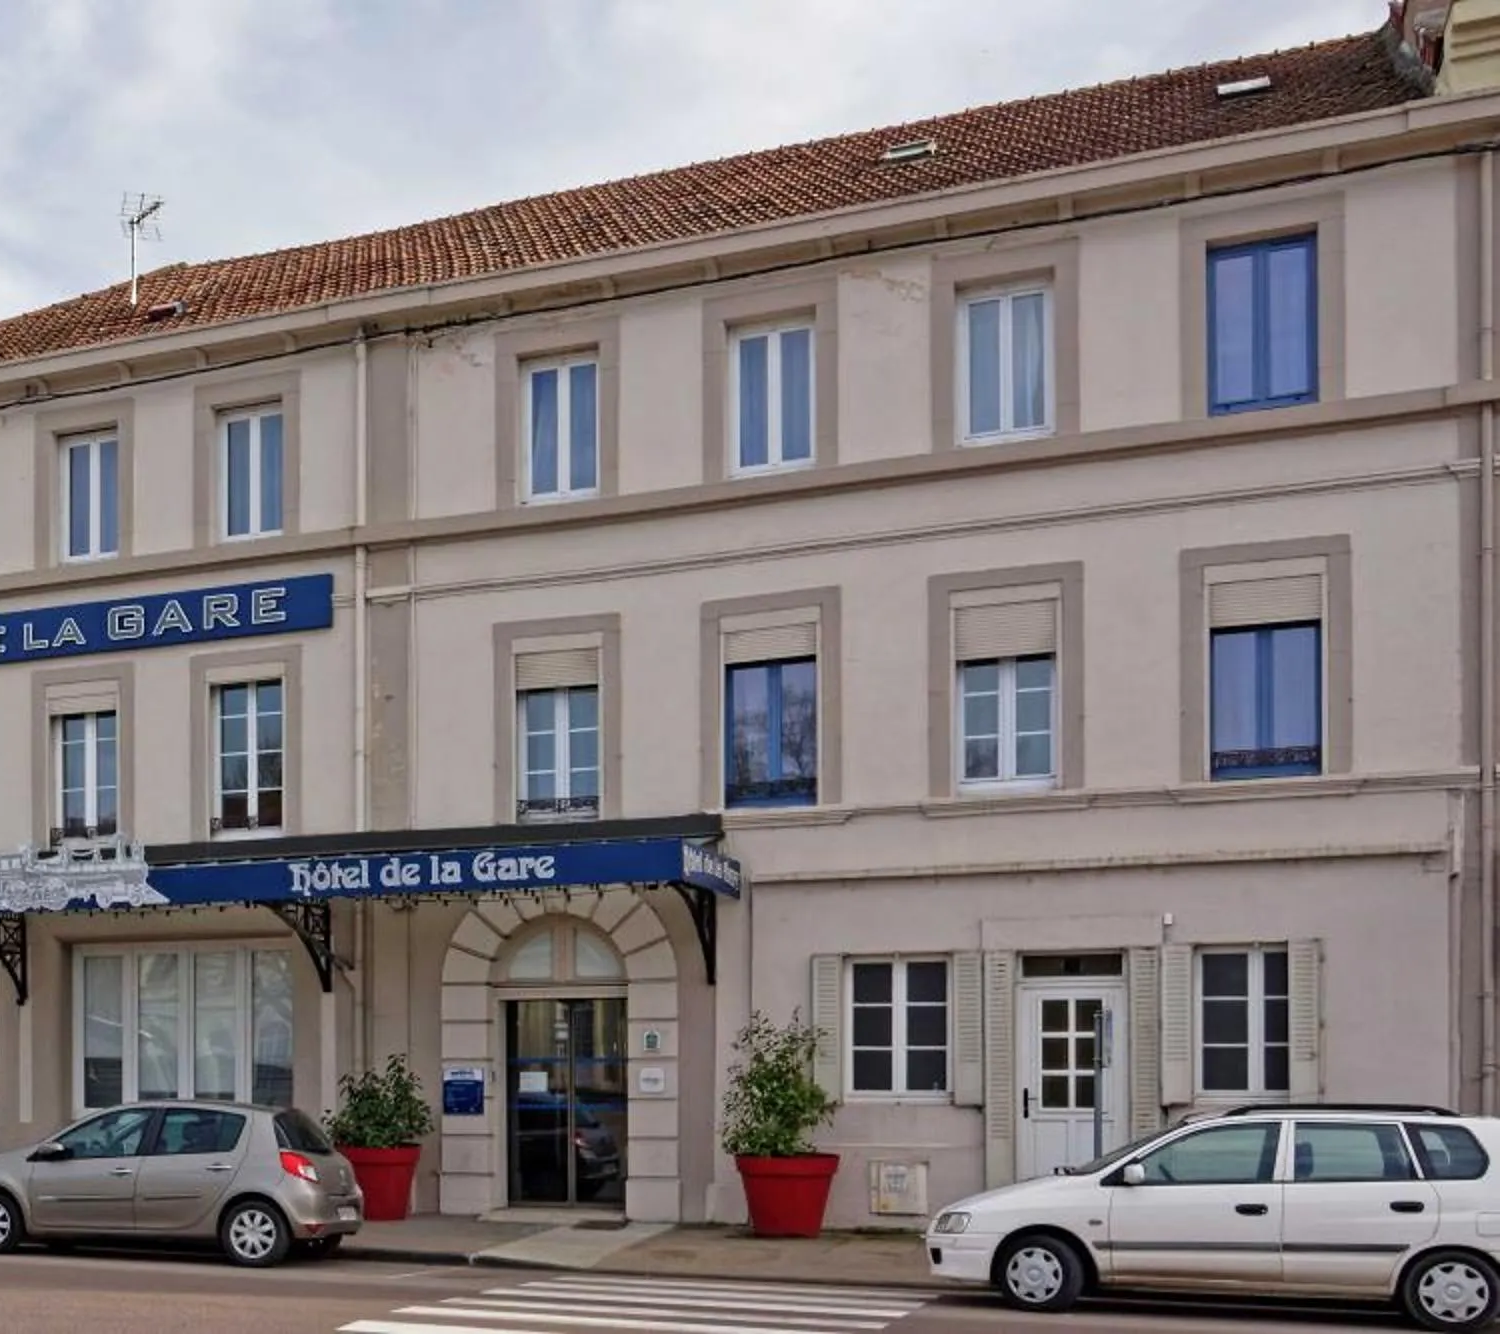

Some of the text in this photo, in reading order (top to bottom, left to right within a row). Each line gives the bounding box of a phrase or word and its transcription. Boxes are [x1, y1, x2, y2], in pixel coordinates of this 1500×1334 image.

[23, 618, 86, 650] LA
[107, 587, 287, 640] GARE
[288, 852, 556, 896] Hôtel de la Gare
